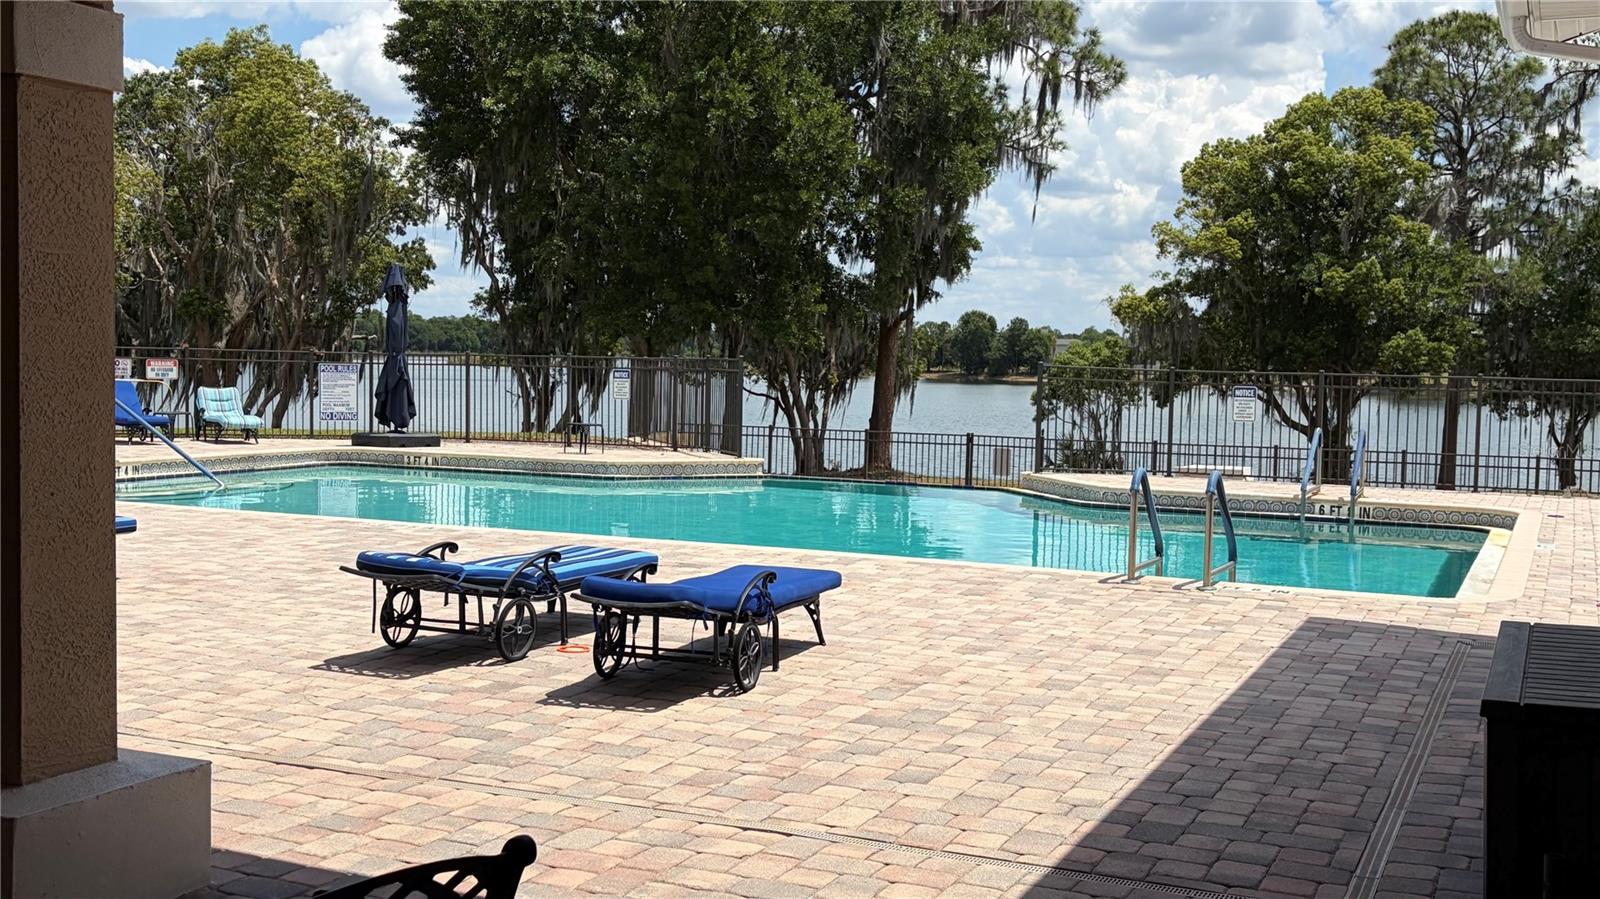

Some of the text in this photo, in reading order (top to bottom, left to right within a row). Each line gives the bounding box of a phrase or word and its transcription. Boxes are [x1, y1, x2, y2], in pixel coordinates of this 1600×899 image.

[1235, 389, 1255, 397] NOTICE
[320, 412, 357, 420] NO DIVING
[406, 455, 440, 466] 3 FT 4 IN
[124, 465, 129, 476] 4
[132, 465, 140, 476] IN
[1318, 504, 1326, 516] 6
[1329, 505, 1343, 517] FT
[1359, 506, 1371, 519] IN
